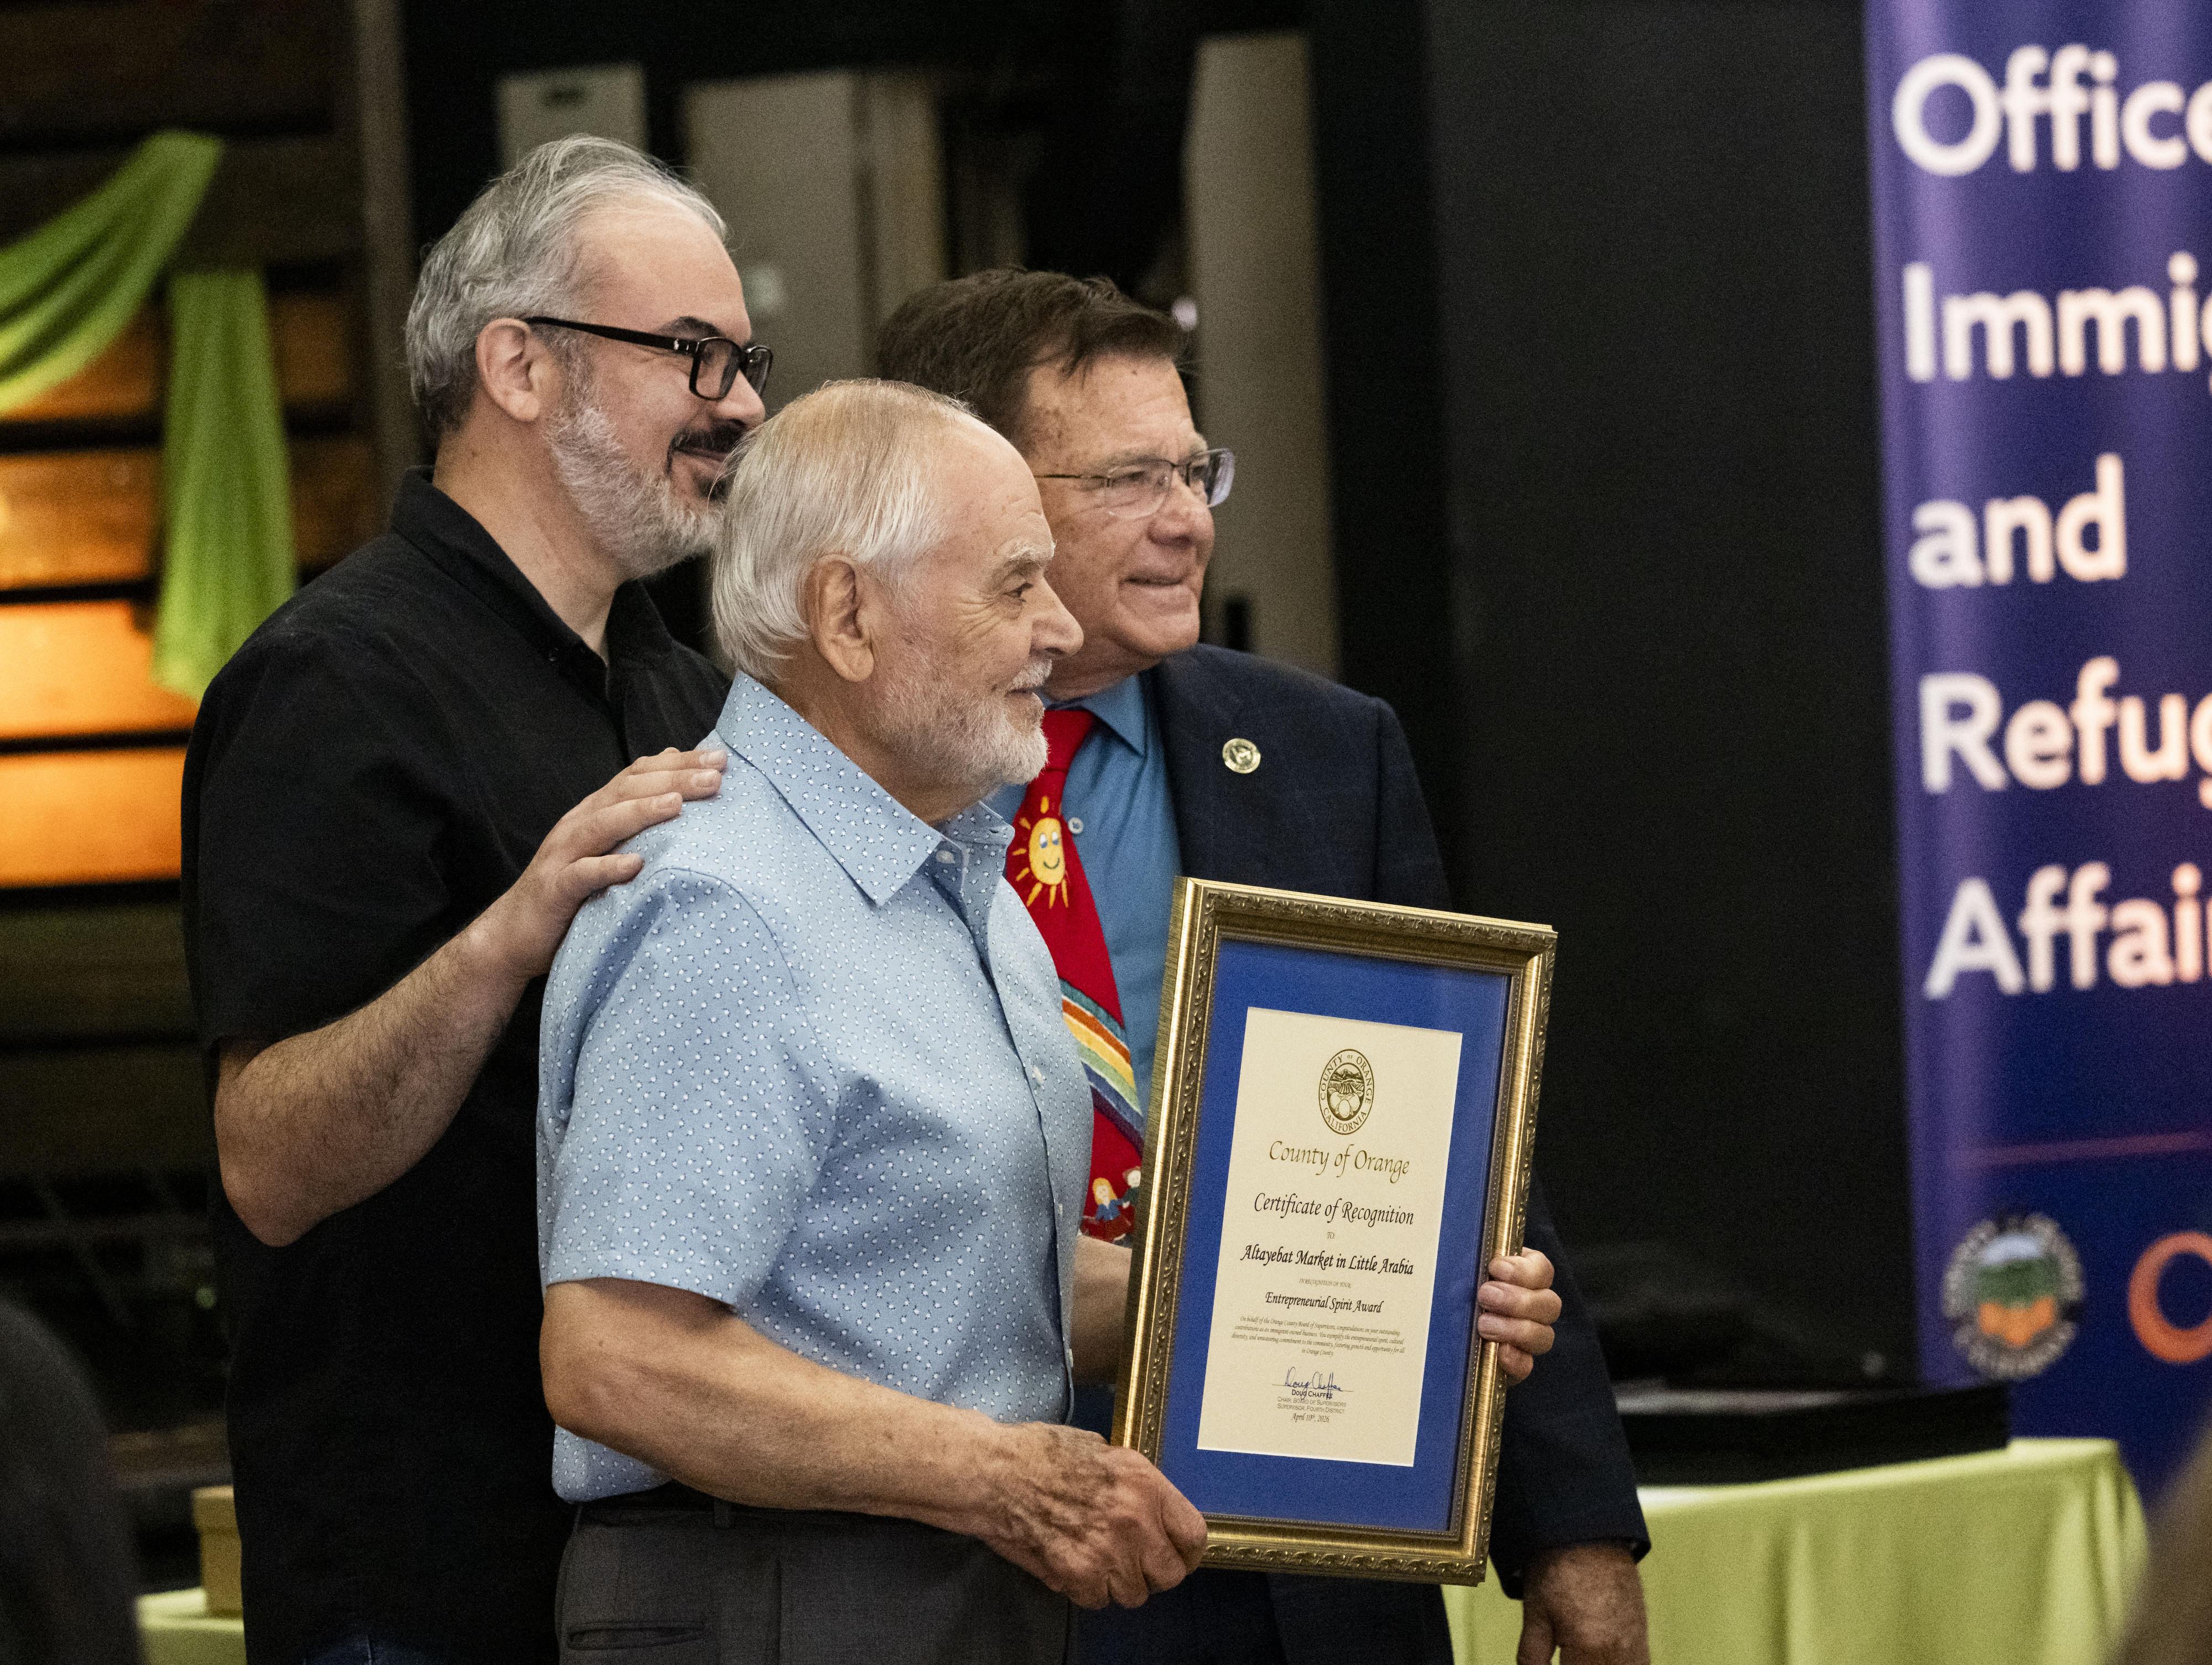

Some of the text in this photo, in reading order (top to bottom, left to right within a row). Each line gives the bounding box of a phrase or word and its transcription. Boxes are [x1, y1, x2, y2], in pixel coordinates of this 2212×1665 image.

[1902, 251, 2212, 396] Immi
[1907, 450, 2128, 589] and
[1923, 861, 2212, 999] Affai
[1321, 1054, 1342, 1100] COUNTY
[1356, 1056, 1373, 1104] ORANGE
[1323, 1107, 1367, 1132] CALIFORNIA
[1270, 1141, 1410, 1184] County of Orange
[1254, 1193, 1414, 1227] Certificate of Recognition
[1240, 1243, 1414, 1274] Altayebat Market in Little Arabia
[1265, 1292, 1384, 1313] Entrepreneurial Spirit Award
[1259, 1317, 1264, 1325] of
[1308, 1391, 1333, 1399] CHAFFEE
[1291, 1413, 1306, 1423] April
